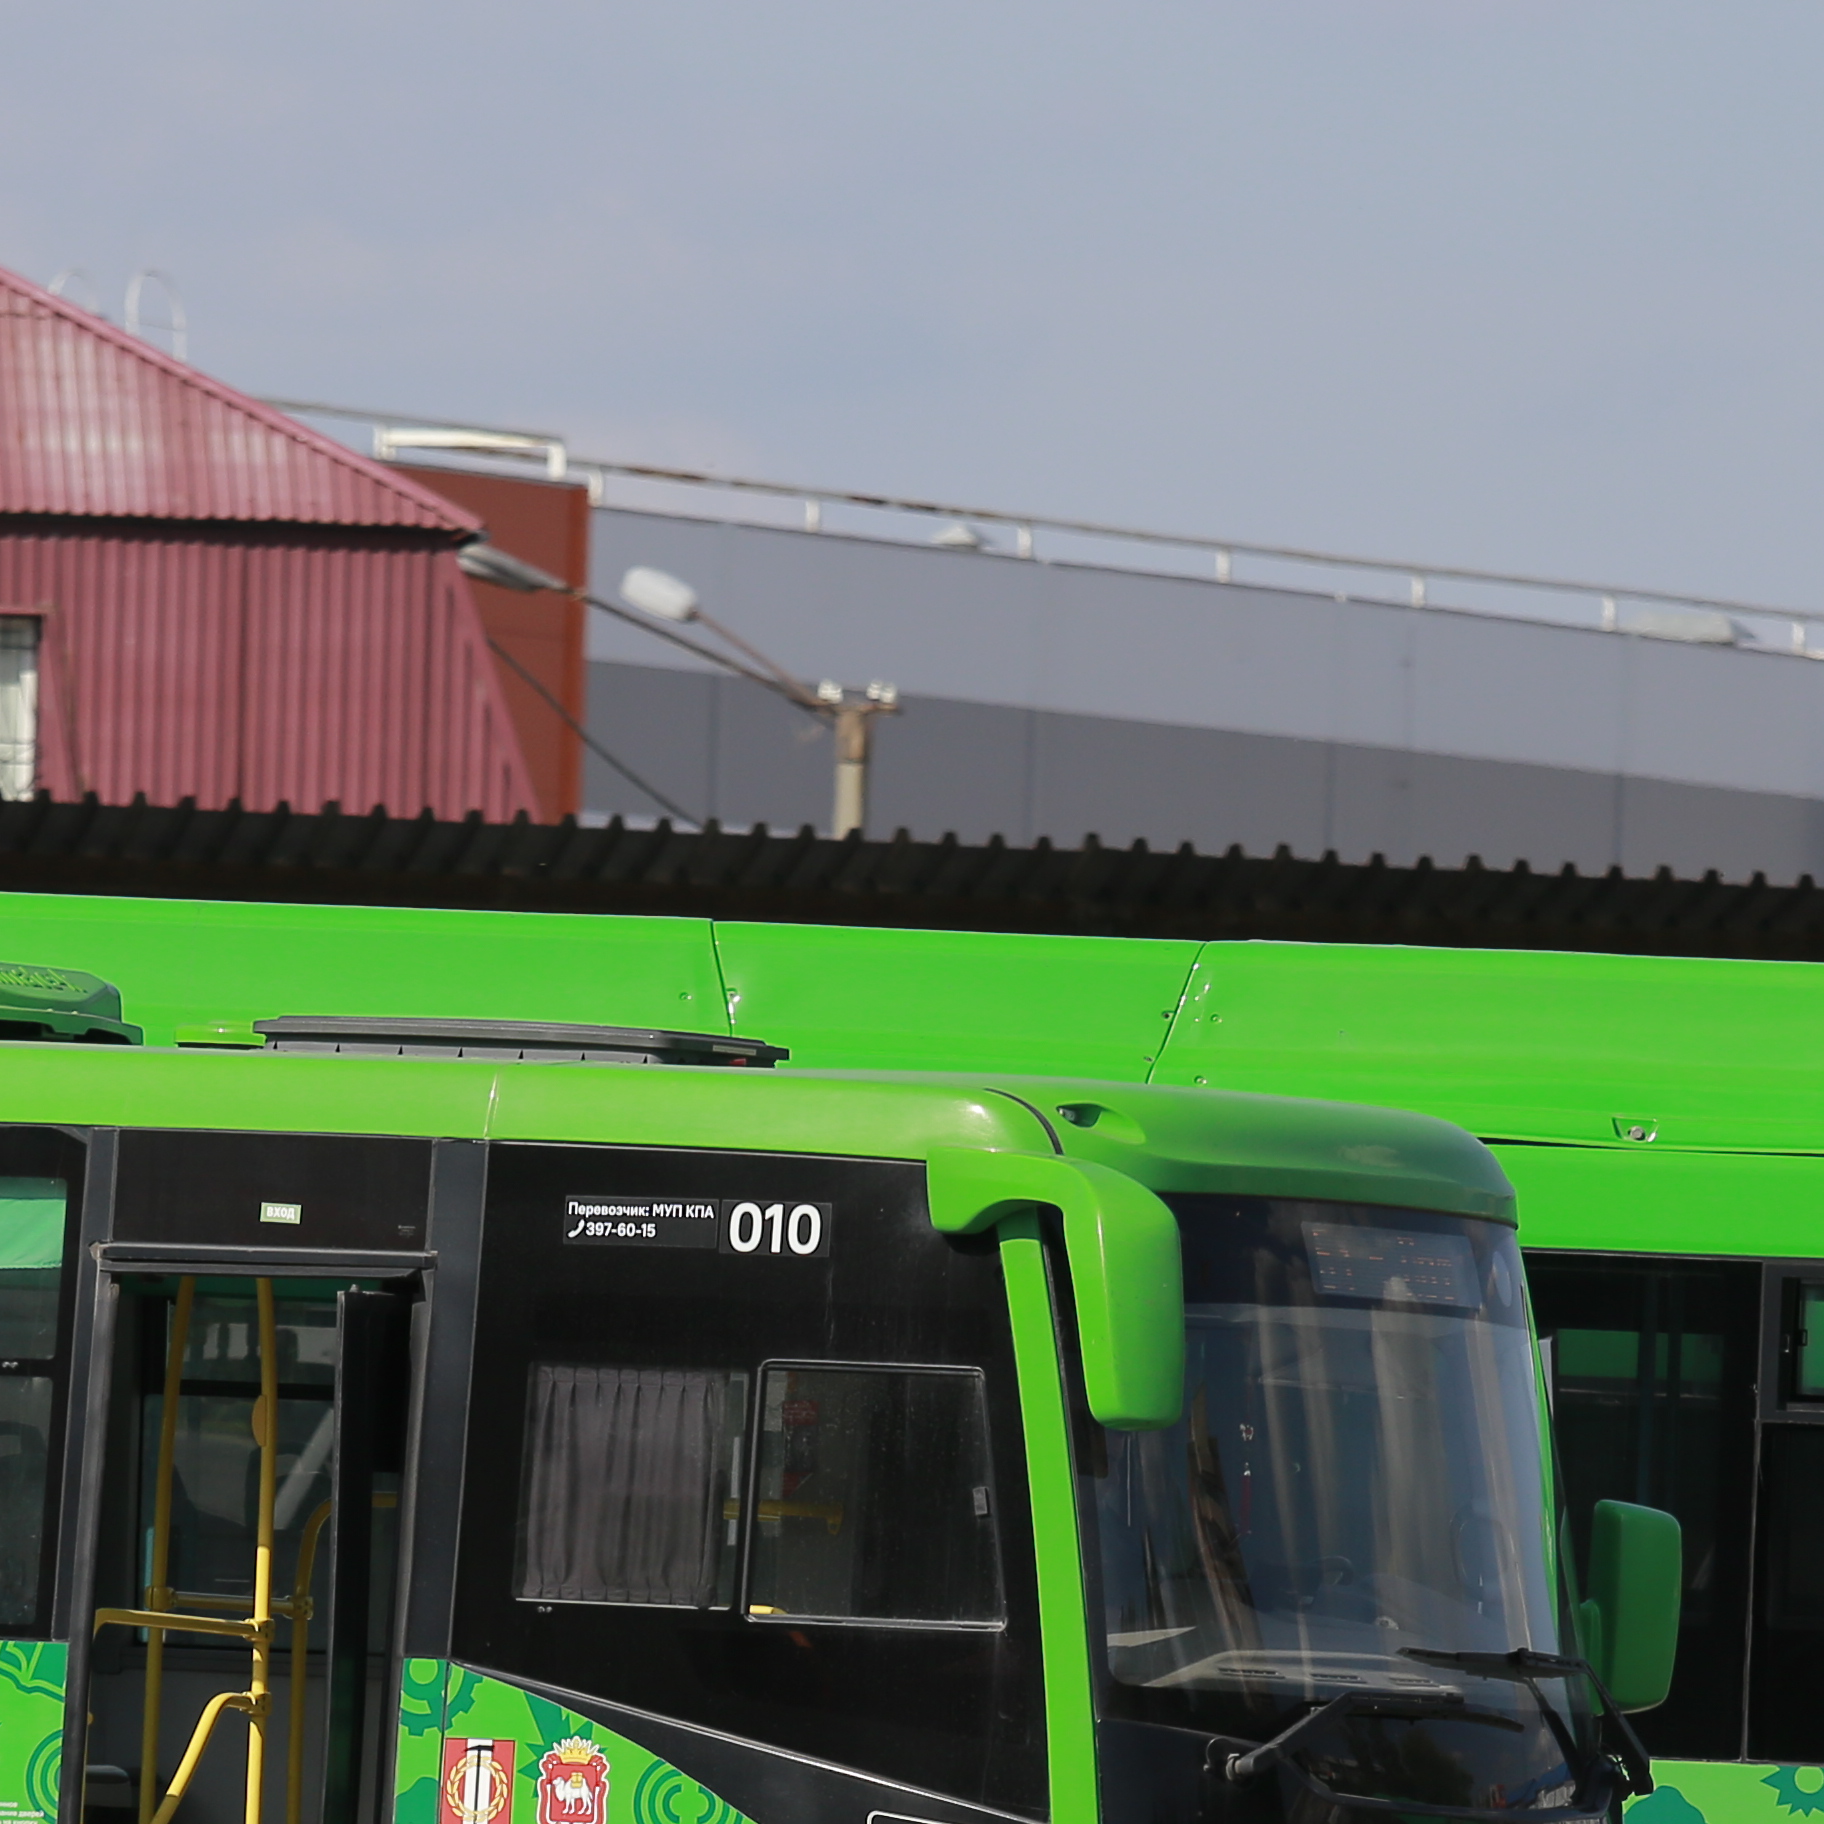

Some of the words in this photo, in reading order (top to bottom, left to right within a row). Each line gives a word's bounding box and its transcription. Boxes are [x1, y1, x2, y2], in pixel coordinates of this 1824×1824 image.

[266, 1205, 296, 1220] ВХОД
[568, 1201, 650, 1218] Перевозчик:
[652, 1203, 683, 1218] МУП
[685, 1204, 715, 1219] КПА
[585, 1221, 656, 1238] 397-60-15
[729, 1202, 821, 1255] 010
